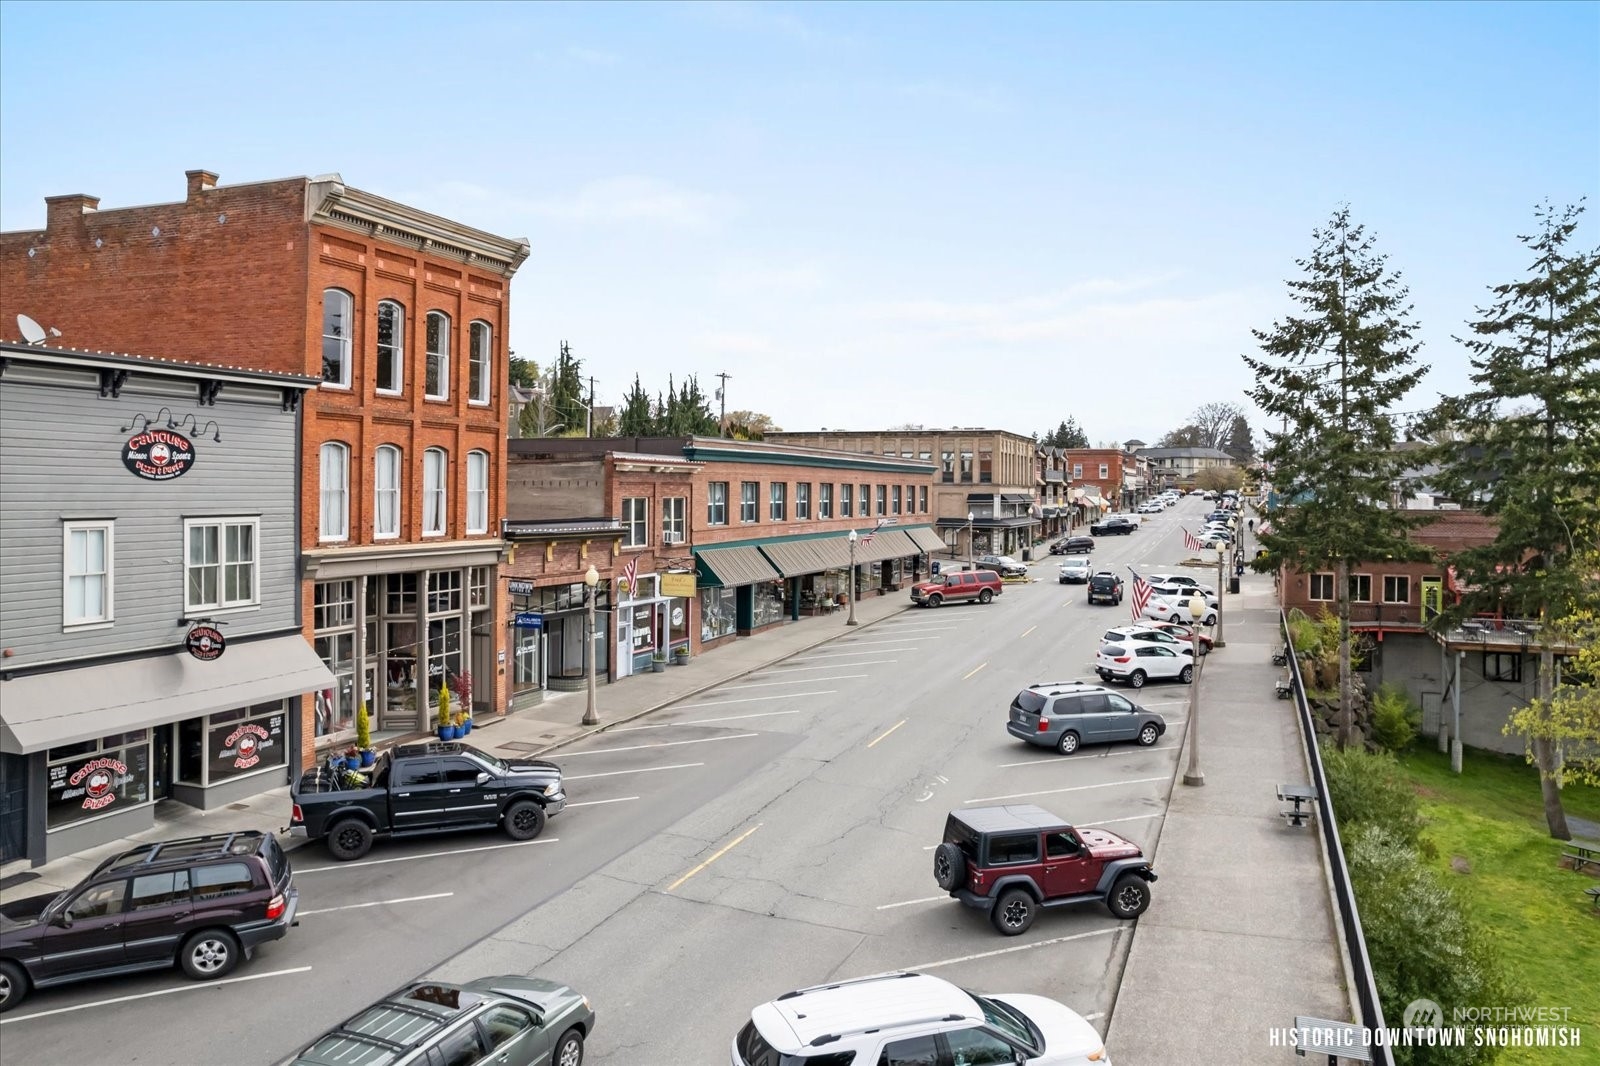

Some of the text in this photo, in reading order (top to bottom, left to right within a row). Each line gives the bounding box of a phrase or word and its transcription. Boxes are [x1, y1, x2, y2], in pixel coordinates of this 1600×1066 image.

[129, 432, 189, 452] Cathouse
[136, 461, 156, 474] Pizza
[162, 461, 184, 474] Pasta
[225, 724, 268, 747] Cathouse
[234, 754, 260, 769] Pizza
[70, 758, 128, 785] Cathouse
[82, 793, 116, 810] Pizza
